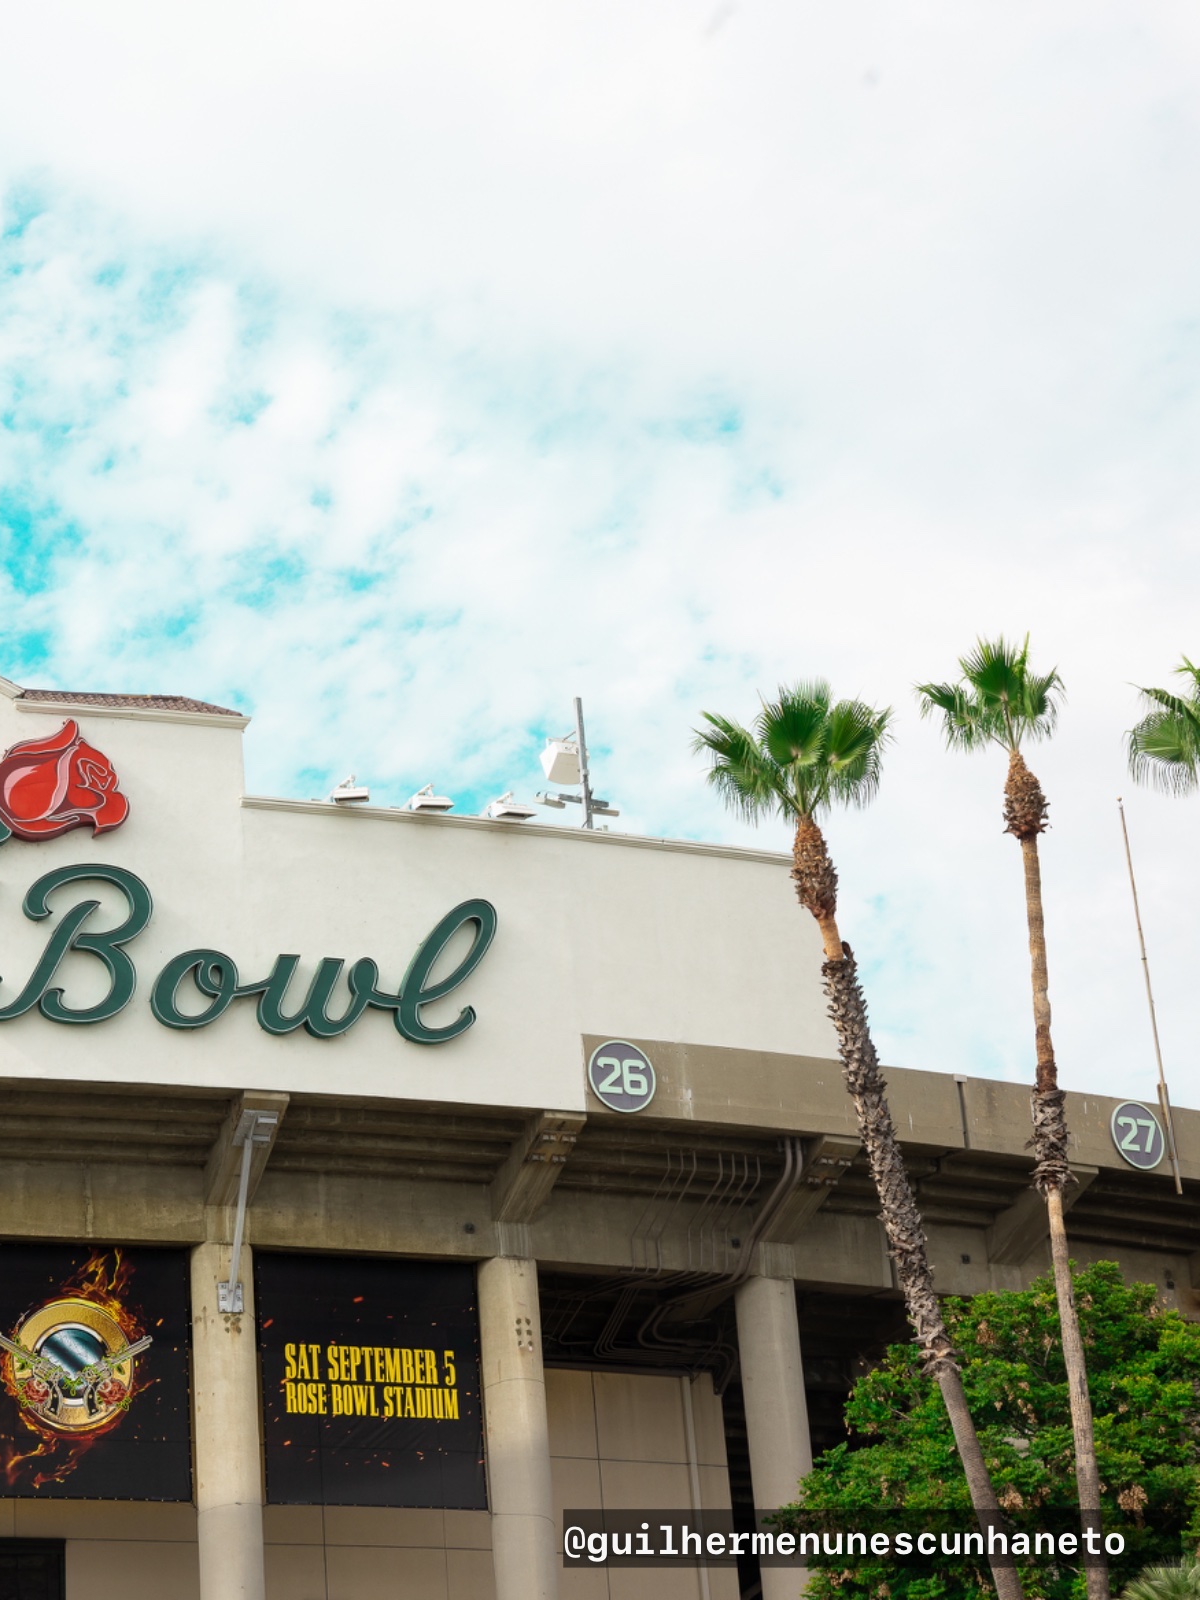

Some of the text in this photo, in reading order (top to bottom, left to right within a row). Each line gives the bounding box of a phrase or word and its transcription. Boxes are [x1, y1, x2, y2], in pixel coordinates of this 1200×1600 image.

[597, 1056, 648, 1096] 26
[1117, 1115, 1156, 1154] 27
[284, 1343, 457, 1386] SAT SEPTEMBER 5
[285, 1382, 460, 1420] ROSE BOWL STADIUM
